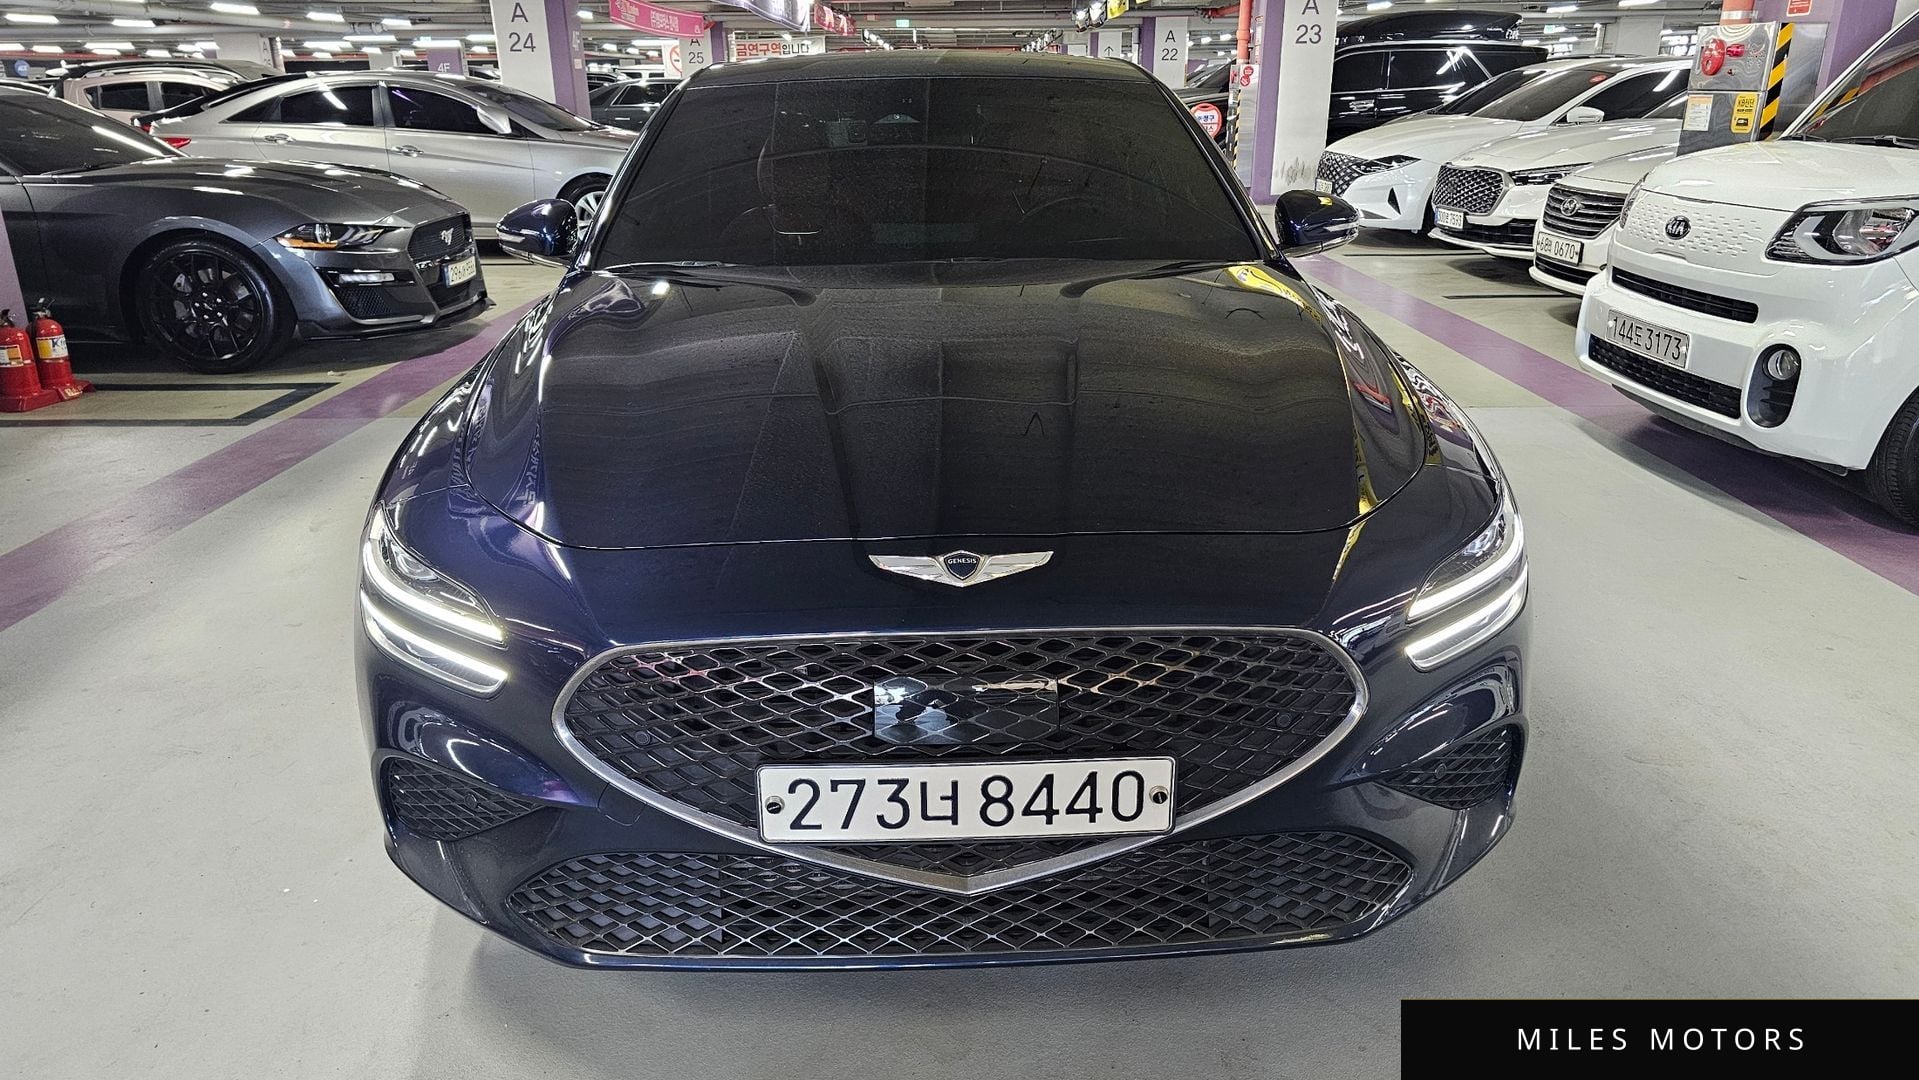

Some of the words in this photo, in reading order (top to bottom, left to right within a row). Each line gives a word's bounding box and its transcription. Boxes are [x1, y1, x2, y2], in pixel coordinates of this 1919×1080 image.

[511, 2, 528, 22] A
[1302, 0, 1319, 15] A
[1165, 30, 1175, 42] A
[1295, 24, 1321, 44] 23
[508, 32, 536, 52] 24
[736, 41, 809, 56] 금연구역입니다
[689, 52, 704, 64] 25
[1161, 48, 1178, 60] 22
[437, 63, 450, 72] 4F
[1667, 220, 1685, 235] KIA
[1554, 240, 1576, 259] 0670
[1645, 328, 1681, 360] 3173
[979, 770, 1144, 827] 8440
